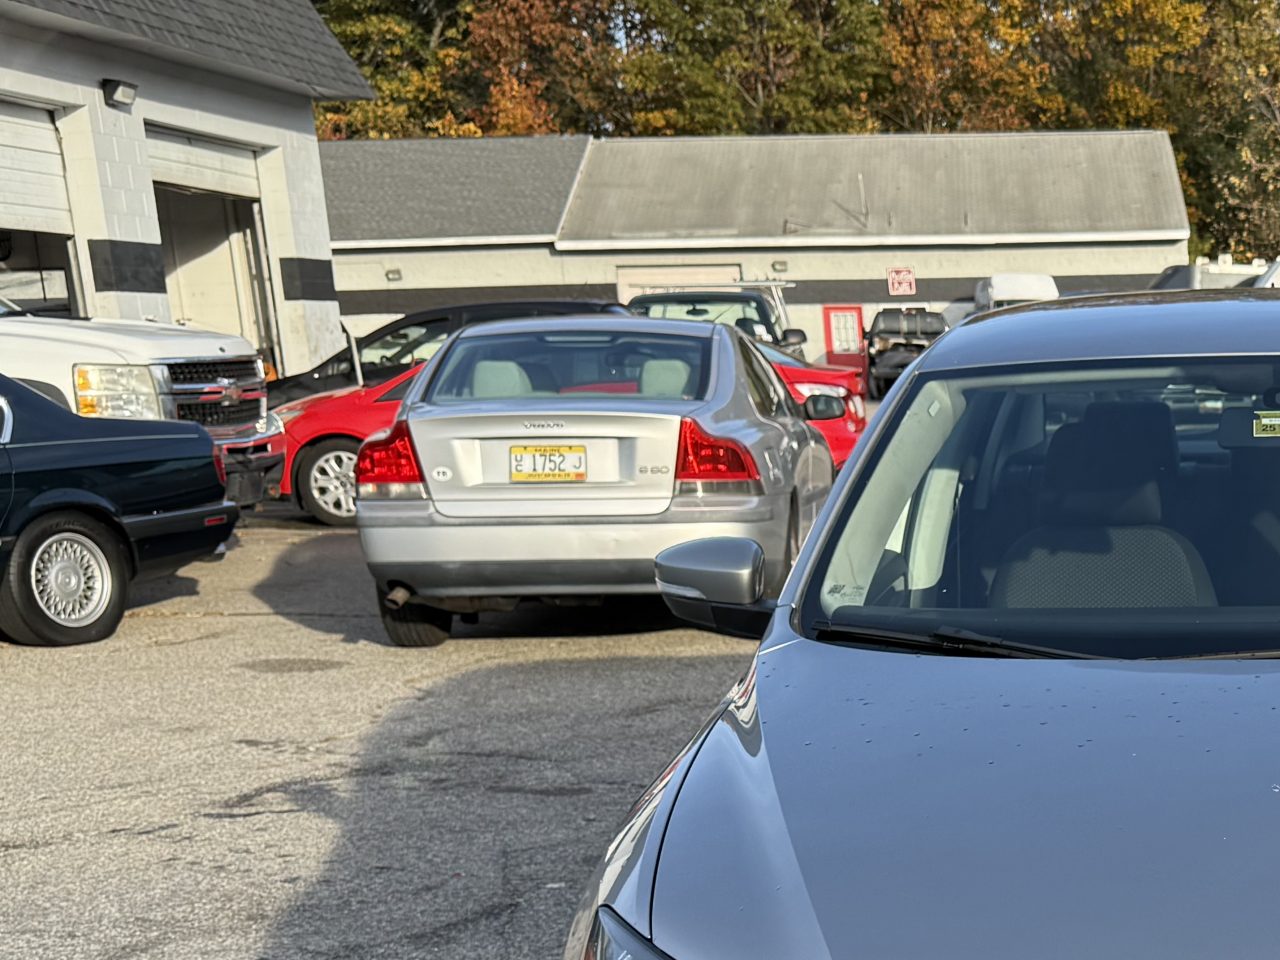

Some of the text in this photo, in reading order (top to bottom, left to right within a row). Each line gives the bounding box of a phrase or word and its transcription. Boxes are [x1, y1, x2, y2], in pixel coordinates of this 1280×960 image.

[1261, 424, 1276, 432] 25
[532, 453, 566, 472] 1752
[573, 455, 582, 470] J
